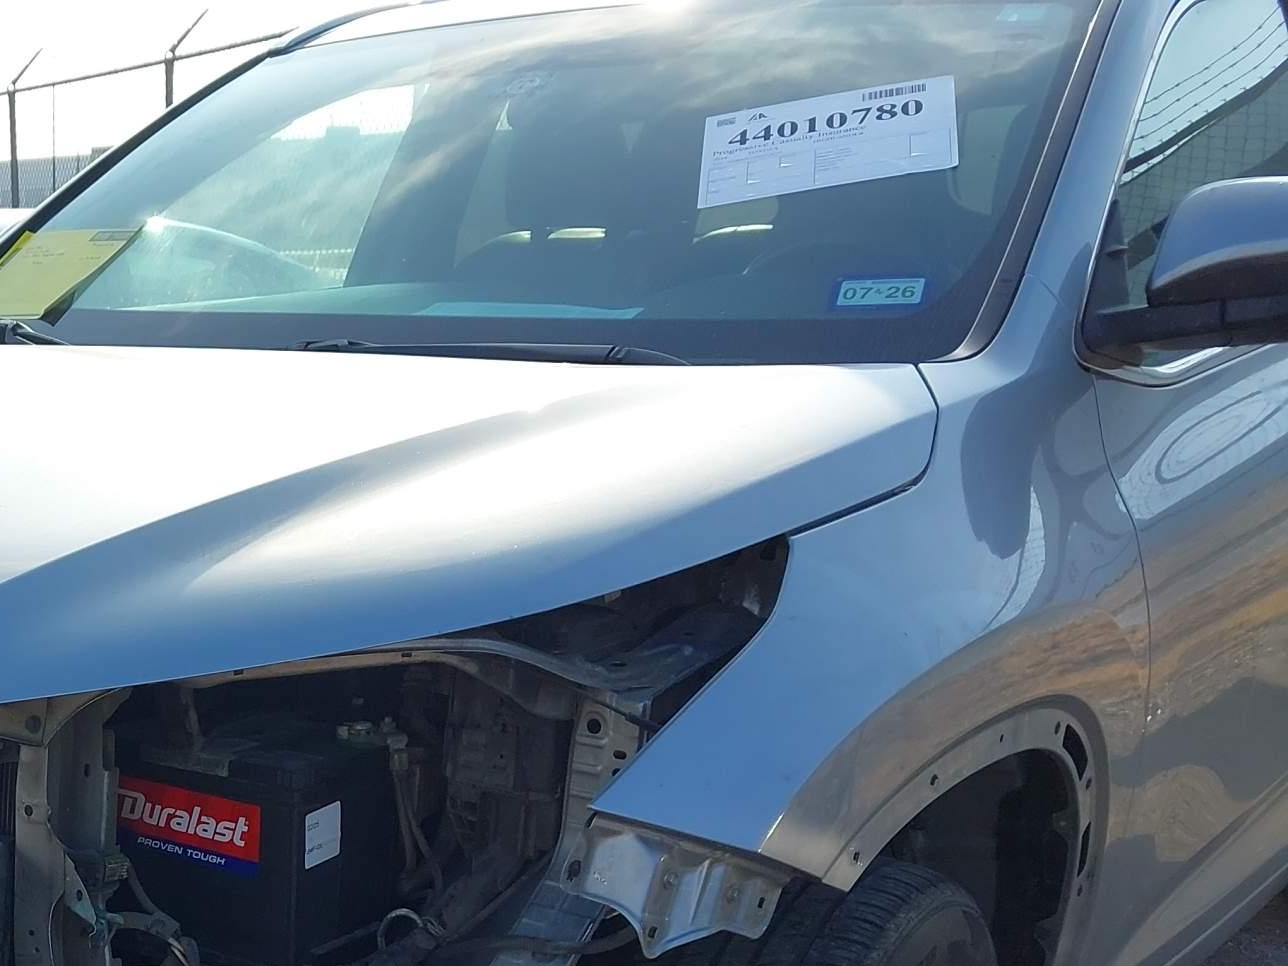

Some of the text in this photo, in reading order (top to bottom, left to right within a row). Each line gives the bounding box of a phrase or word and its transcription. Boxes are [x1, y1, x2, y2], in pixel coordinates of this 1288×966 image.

[728, 99, 924, 146] 44010780
[842, 286, 917, 300] 07 26
[116, 788, 249, 848] Duralast
[137, 836, 226, 866] PROVEN TOUGH
